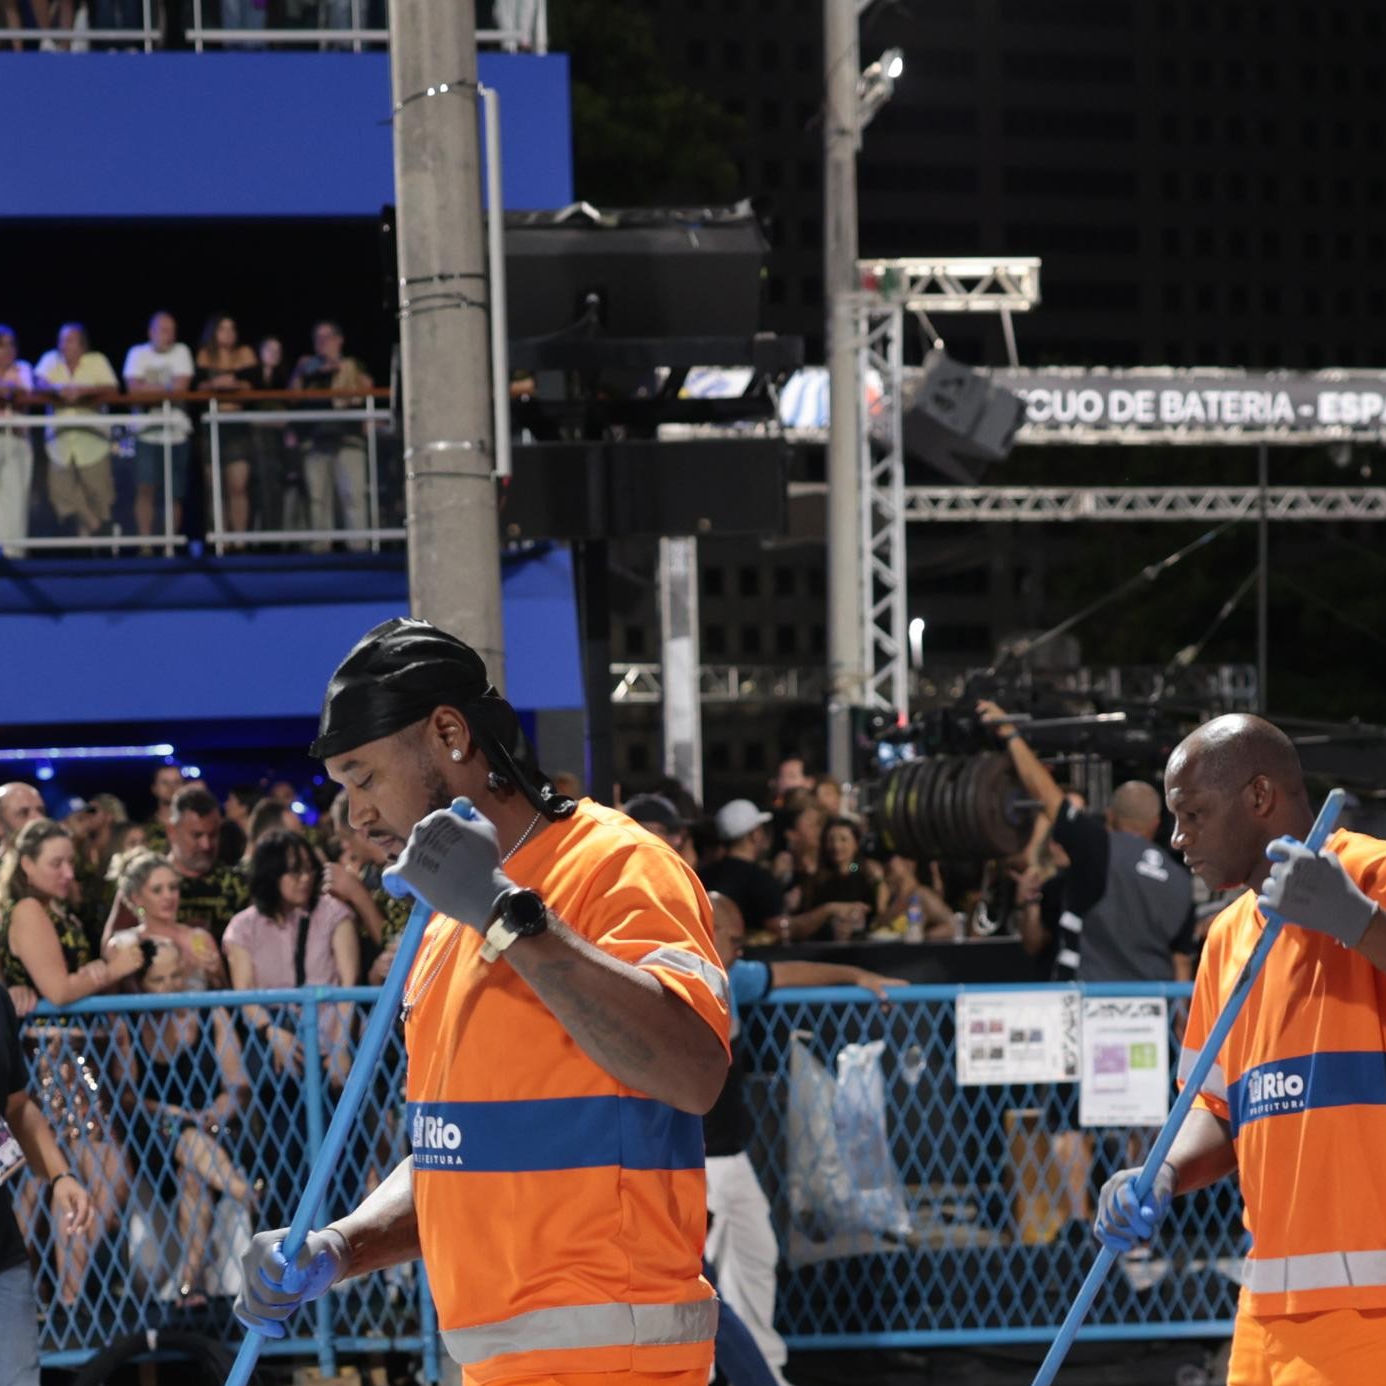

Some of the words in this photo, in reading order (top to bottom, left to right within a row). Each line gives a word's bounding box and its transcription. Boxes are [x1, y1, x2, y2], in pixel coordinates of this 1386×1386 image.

[1017, 388, 1104, 422] CUO
[1109, 389, 1156, 422] DE
[1160, 389, 1295, 423] BATERIA
[1263, 1071, 1304, 1100] Rio
[424, 1115, 462, 1150] Rio
